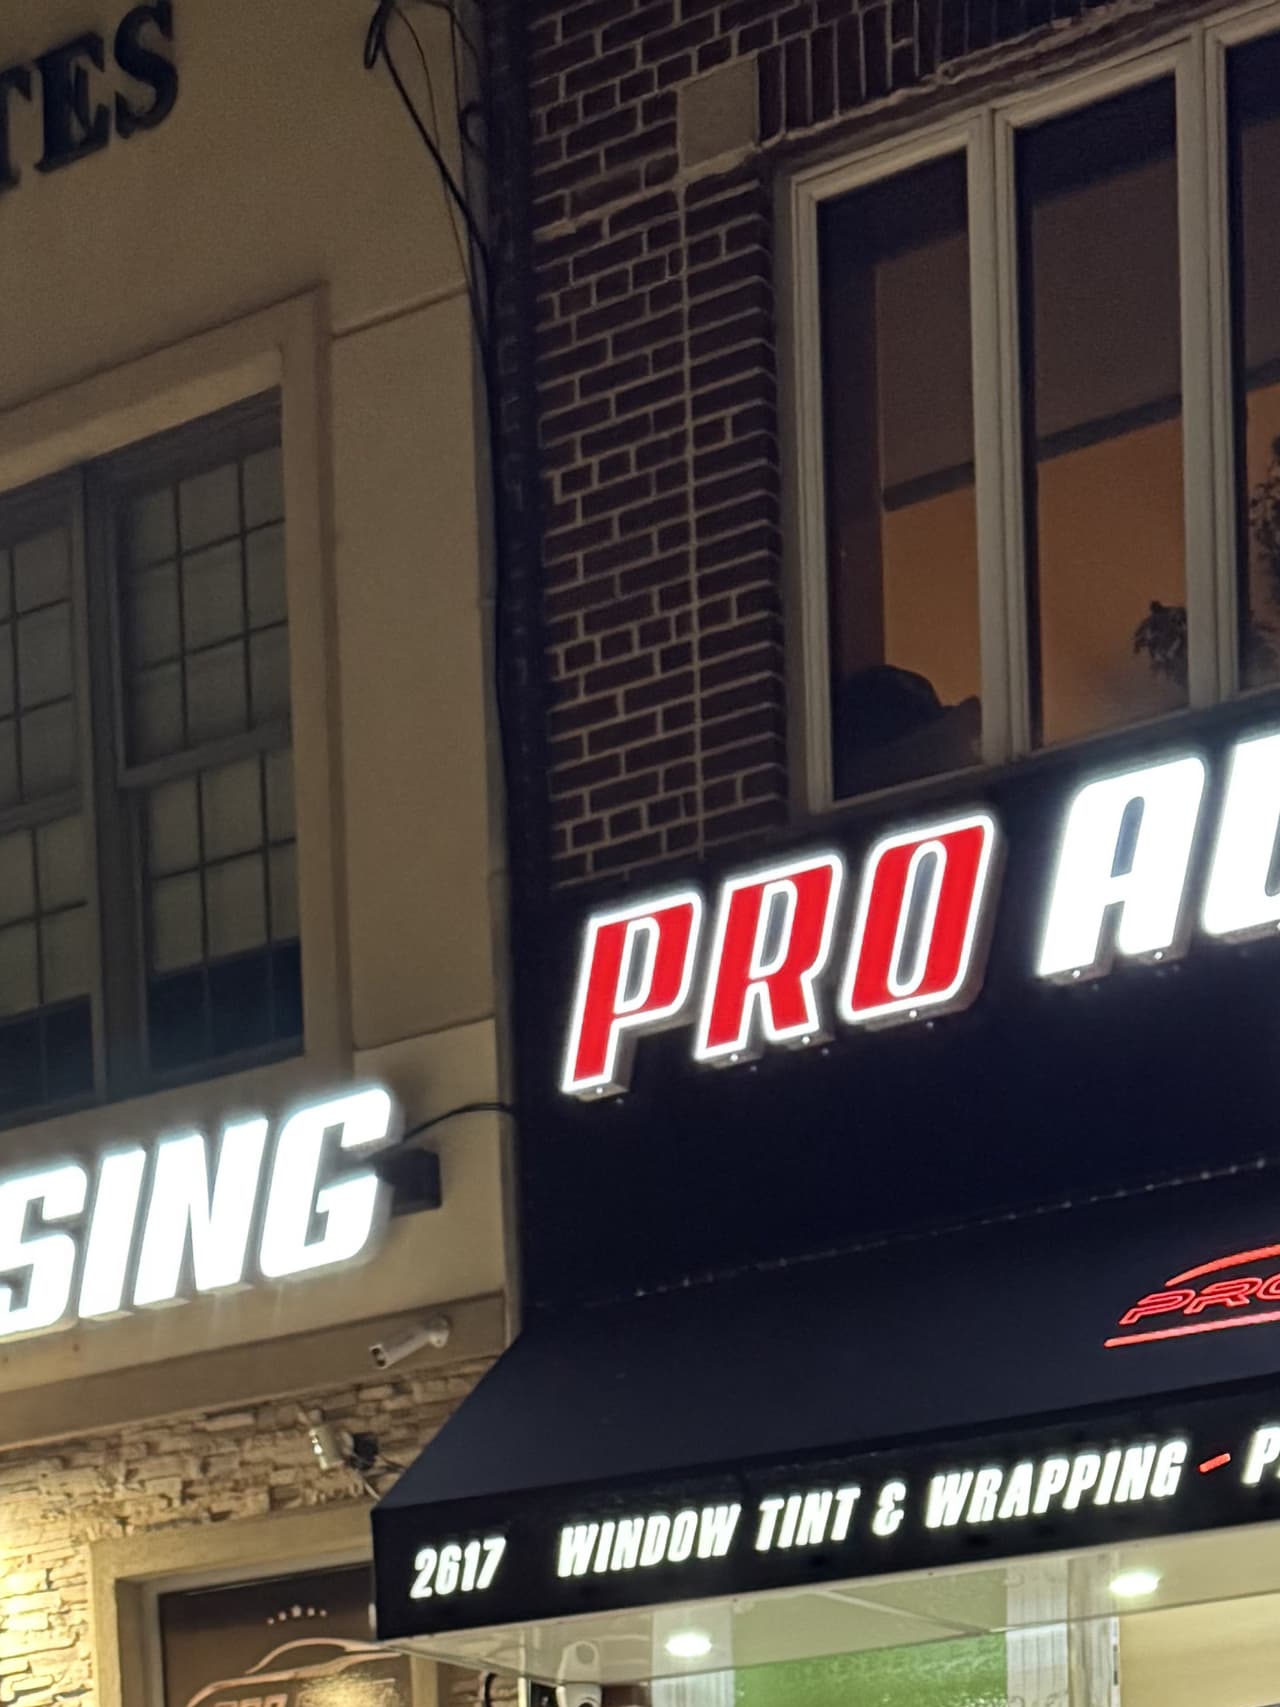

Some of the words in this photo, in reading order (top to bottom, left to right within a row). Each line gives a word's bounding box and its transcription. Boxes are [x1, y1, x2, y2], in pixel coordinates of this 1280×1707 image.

[560, 814, 998, 1097] PRO
[410, 1535, 508, 1601] 2617
[557, 1503, 741, 1579] WINDOW
[754, 1481, 862, 1552] TINT
[871, 1480, 907, 1537] &
[925, 1439, 1190, 1530] WRAPPING
